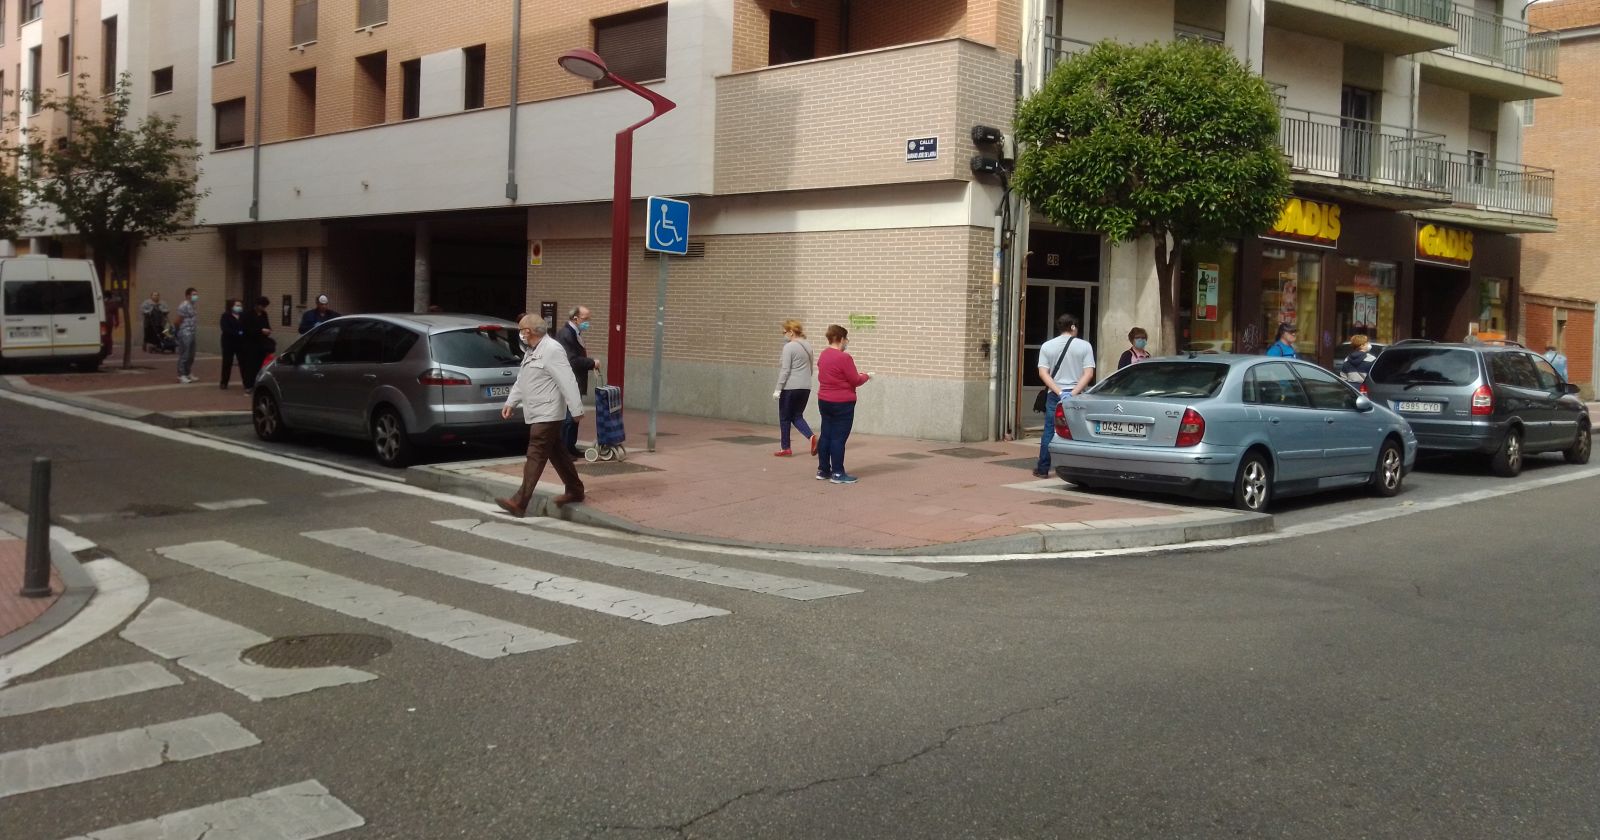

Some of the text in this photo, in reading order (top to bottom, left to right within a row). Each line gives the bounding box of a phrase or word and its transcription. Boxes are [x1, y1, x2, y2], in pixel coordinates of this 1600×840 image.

[1419, 224, 1473, 261] GADIS
[1102, 422, 1145, 433] 0494 CNP
